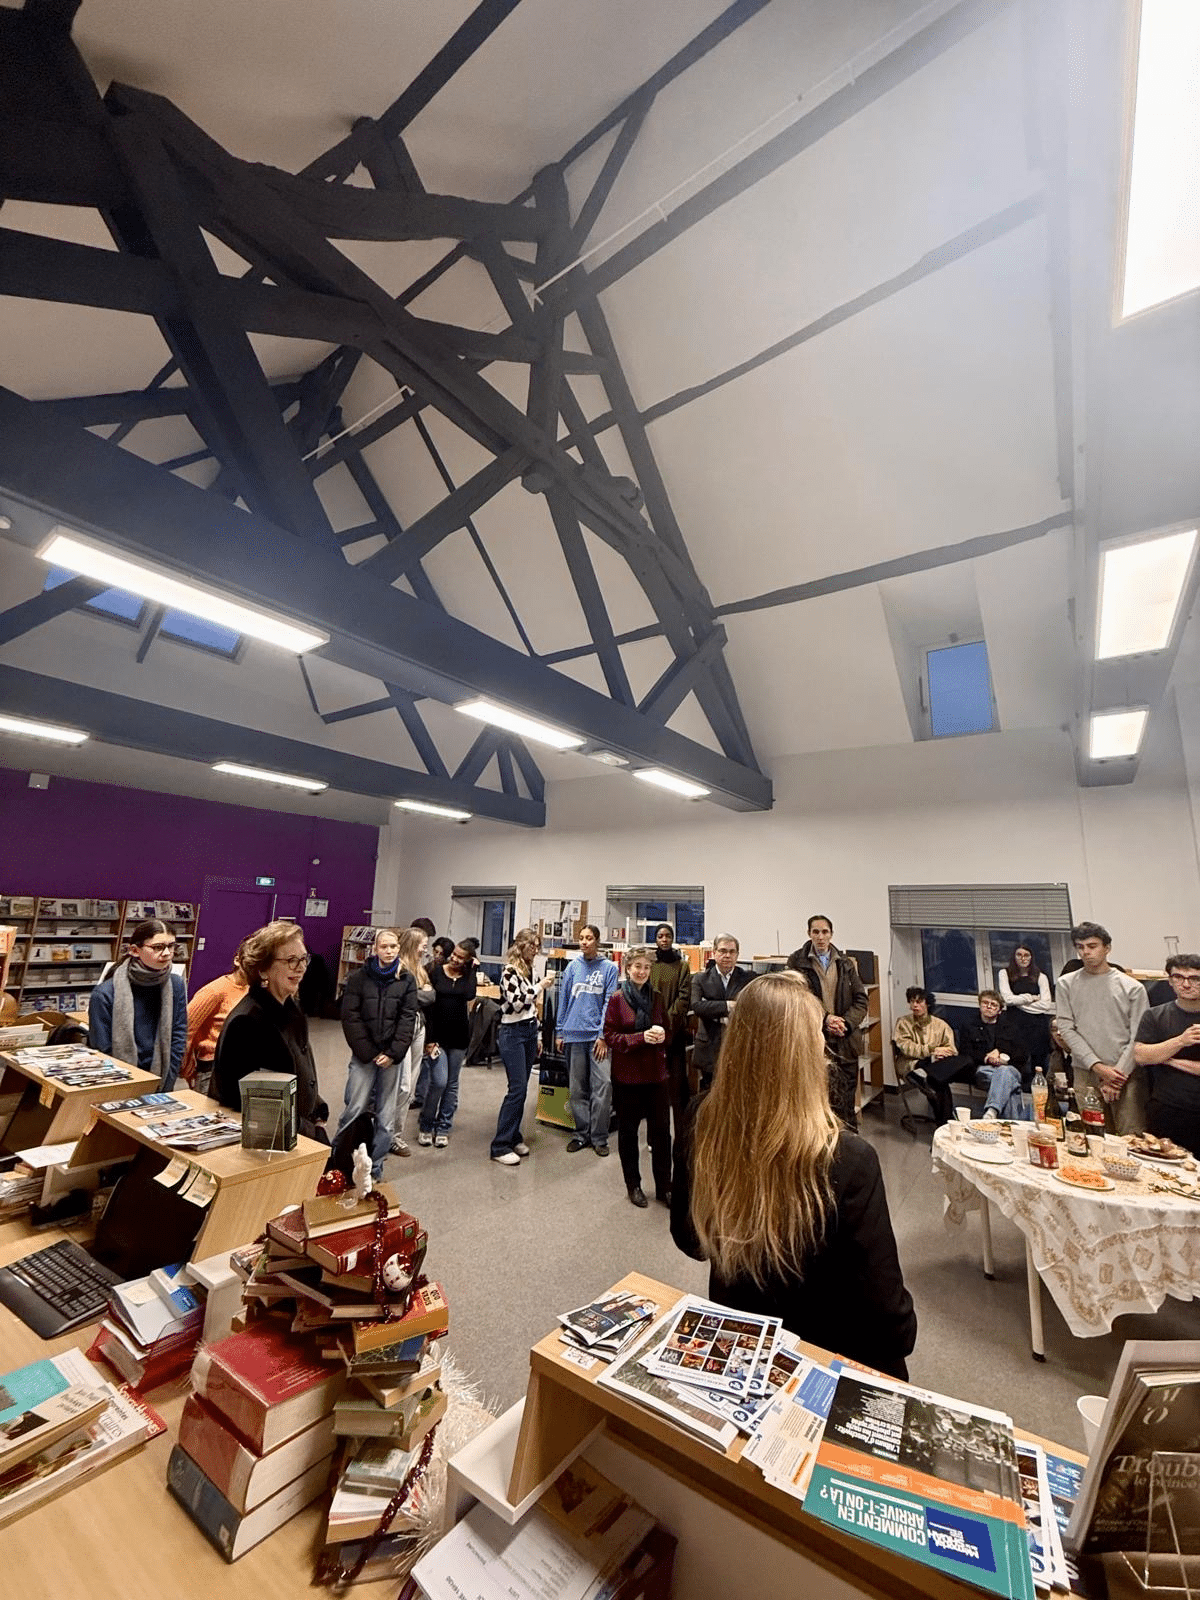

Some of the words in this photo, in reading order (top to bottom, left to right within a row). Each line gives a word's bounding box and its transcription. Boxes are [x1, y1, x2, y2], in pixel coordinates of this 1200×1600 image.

[1113, 1455, 1200, 1478] Troub
[820, 1484, 828, 1499] ?
[830, 1486, 843, 1506] LÀ
[837, 1504, 855, 1523] EN
[846, 1492, 925, 1530] ARRIVE-T-ON
[856, 1510, 927, 1546] COMMENT
